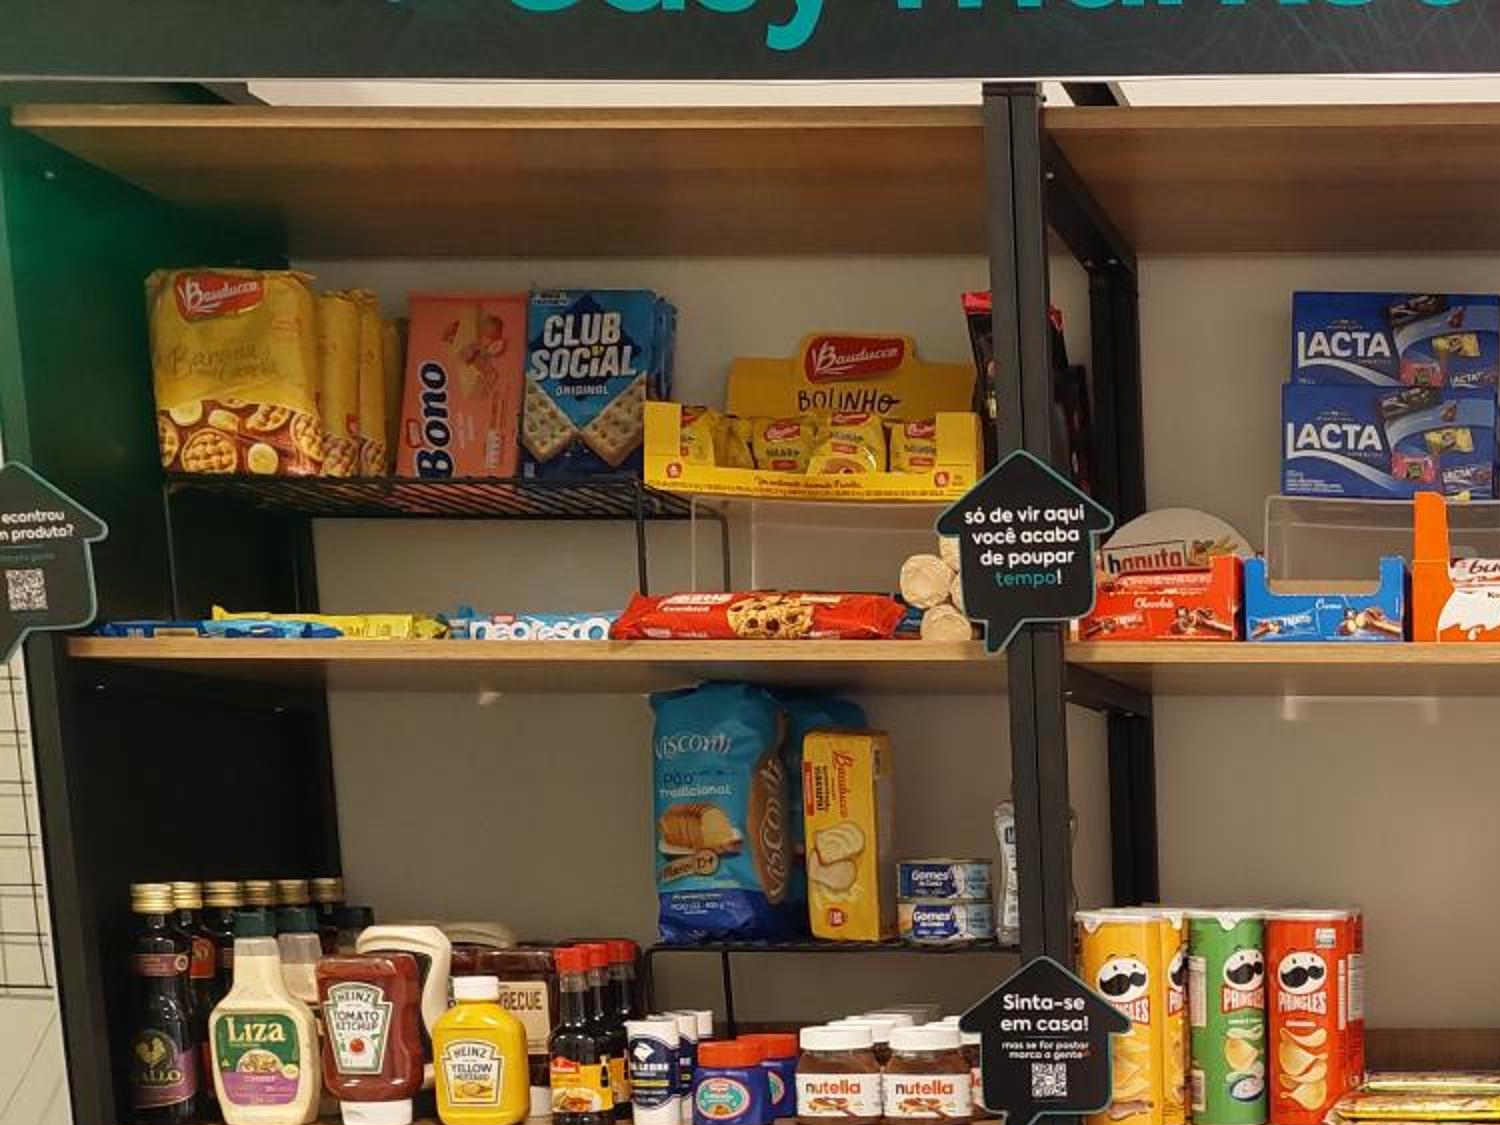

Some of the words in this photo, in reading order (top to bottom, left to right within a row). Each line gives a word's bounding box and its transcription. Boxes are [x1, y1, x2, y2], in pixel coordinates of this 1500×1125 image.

[543, 312, 642, 349] CLUB
[1297, 331, 1391, 368] LACTA
[815, 342, 898, 377] Bauducco
[555, 383, 609, 396] ORIGINAL
[799, 390, 903, 414] BOLINHO
[1287, 422, 1383, 459] LACTA
[965, 508, 986, 524] só
[990, 506, 1013, 523] de
[1017, 505, 1041, 523] vir
[1044, 504, 1086, 525] aqui
[12, 525, 75, 544] produto?
[972, 528, 1017, 545] você
[1020, 528, 1080, 544] acaba
[981, 550, 1005, 566] de
[1008, 551, 1076, 568] poupar
[1108, 551, 1183, 583] hanuta
[996, 570, 1063, 588] tempo!
[336, 990, 373, 1002] HEINZ
[1003, 994, 1085, 1011] Sinta-se
[333, 1009, 381, 1022] TOMATO
[1001, 1016, 1031, 1032] em
[1035, 1015, 1089, 1032] casa!
[453, 1048, 489, 1058] HEINZ
[451, 1062, 493, 1074] YELLOW
[806, 1079, 862, 1096] nutella
[895, 1079, 953, 1097] nutella
